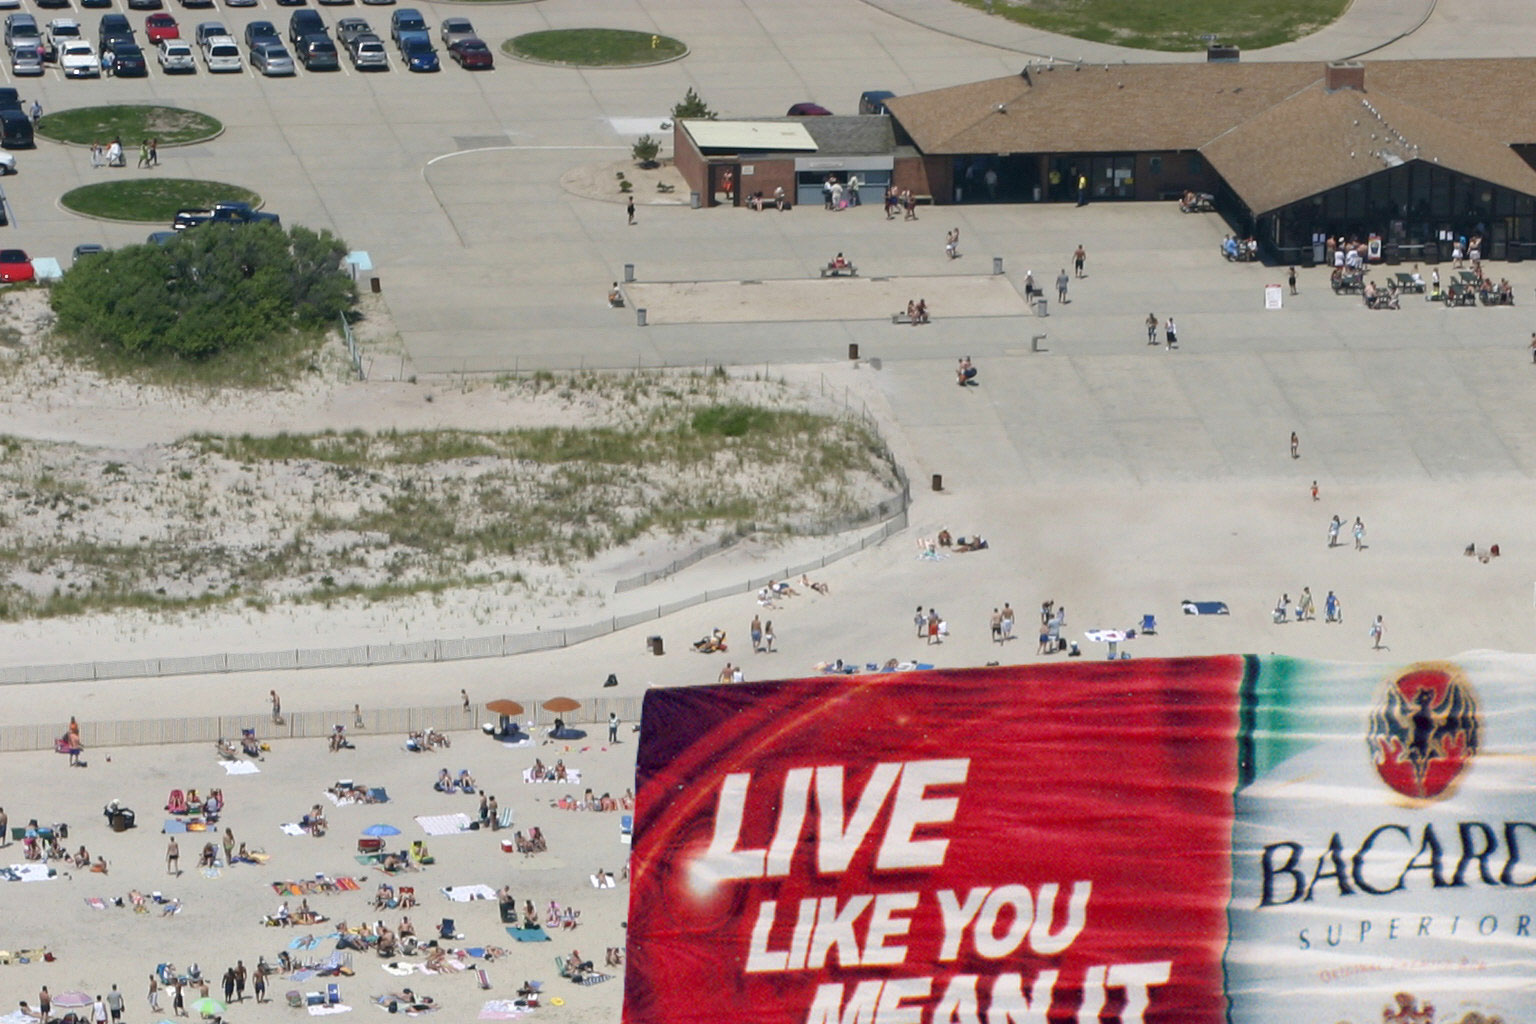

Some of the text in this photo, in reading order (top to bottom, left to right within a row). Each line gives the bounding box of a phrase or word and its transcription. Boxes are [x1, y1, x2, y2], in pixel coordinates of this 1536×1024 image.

[704, 758, 971, 879] LIVE
[744, 880, 1093, 973] LIKE YOU
[1298, 914, 1533, 950] SUPERIOR
